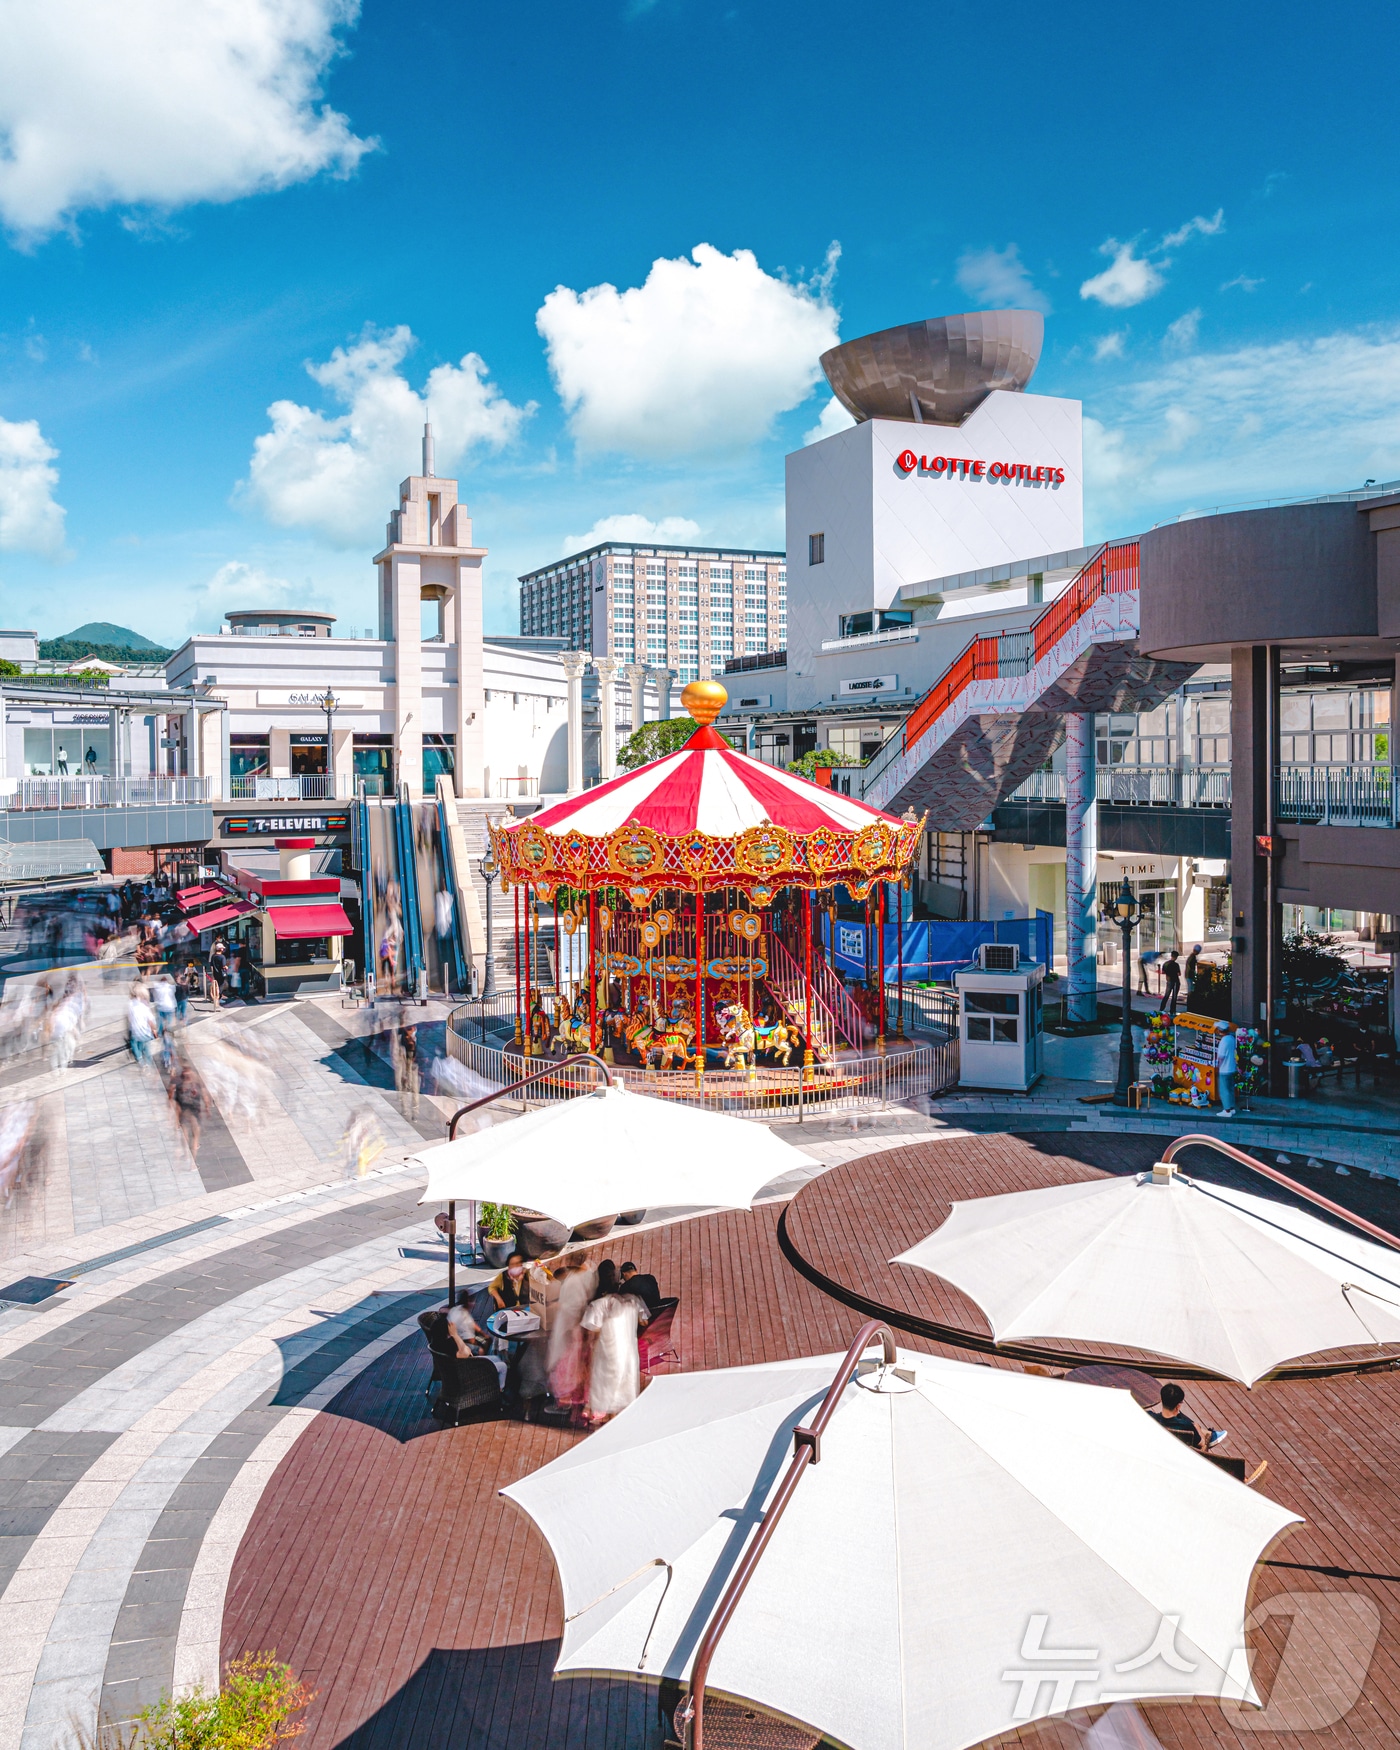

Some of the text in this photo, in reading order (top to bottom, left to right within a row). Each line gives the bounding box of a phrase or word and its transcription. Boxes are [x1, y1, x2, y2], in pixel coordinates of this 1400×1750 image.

[921, 455, 1066, 483] LOTTE OUTLETS
[848, 681, 872, 690] LACOSTE
[1121, 864, 1156, 875] TIME
[530, 1287, 545, 1306] NIKE
